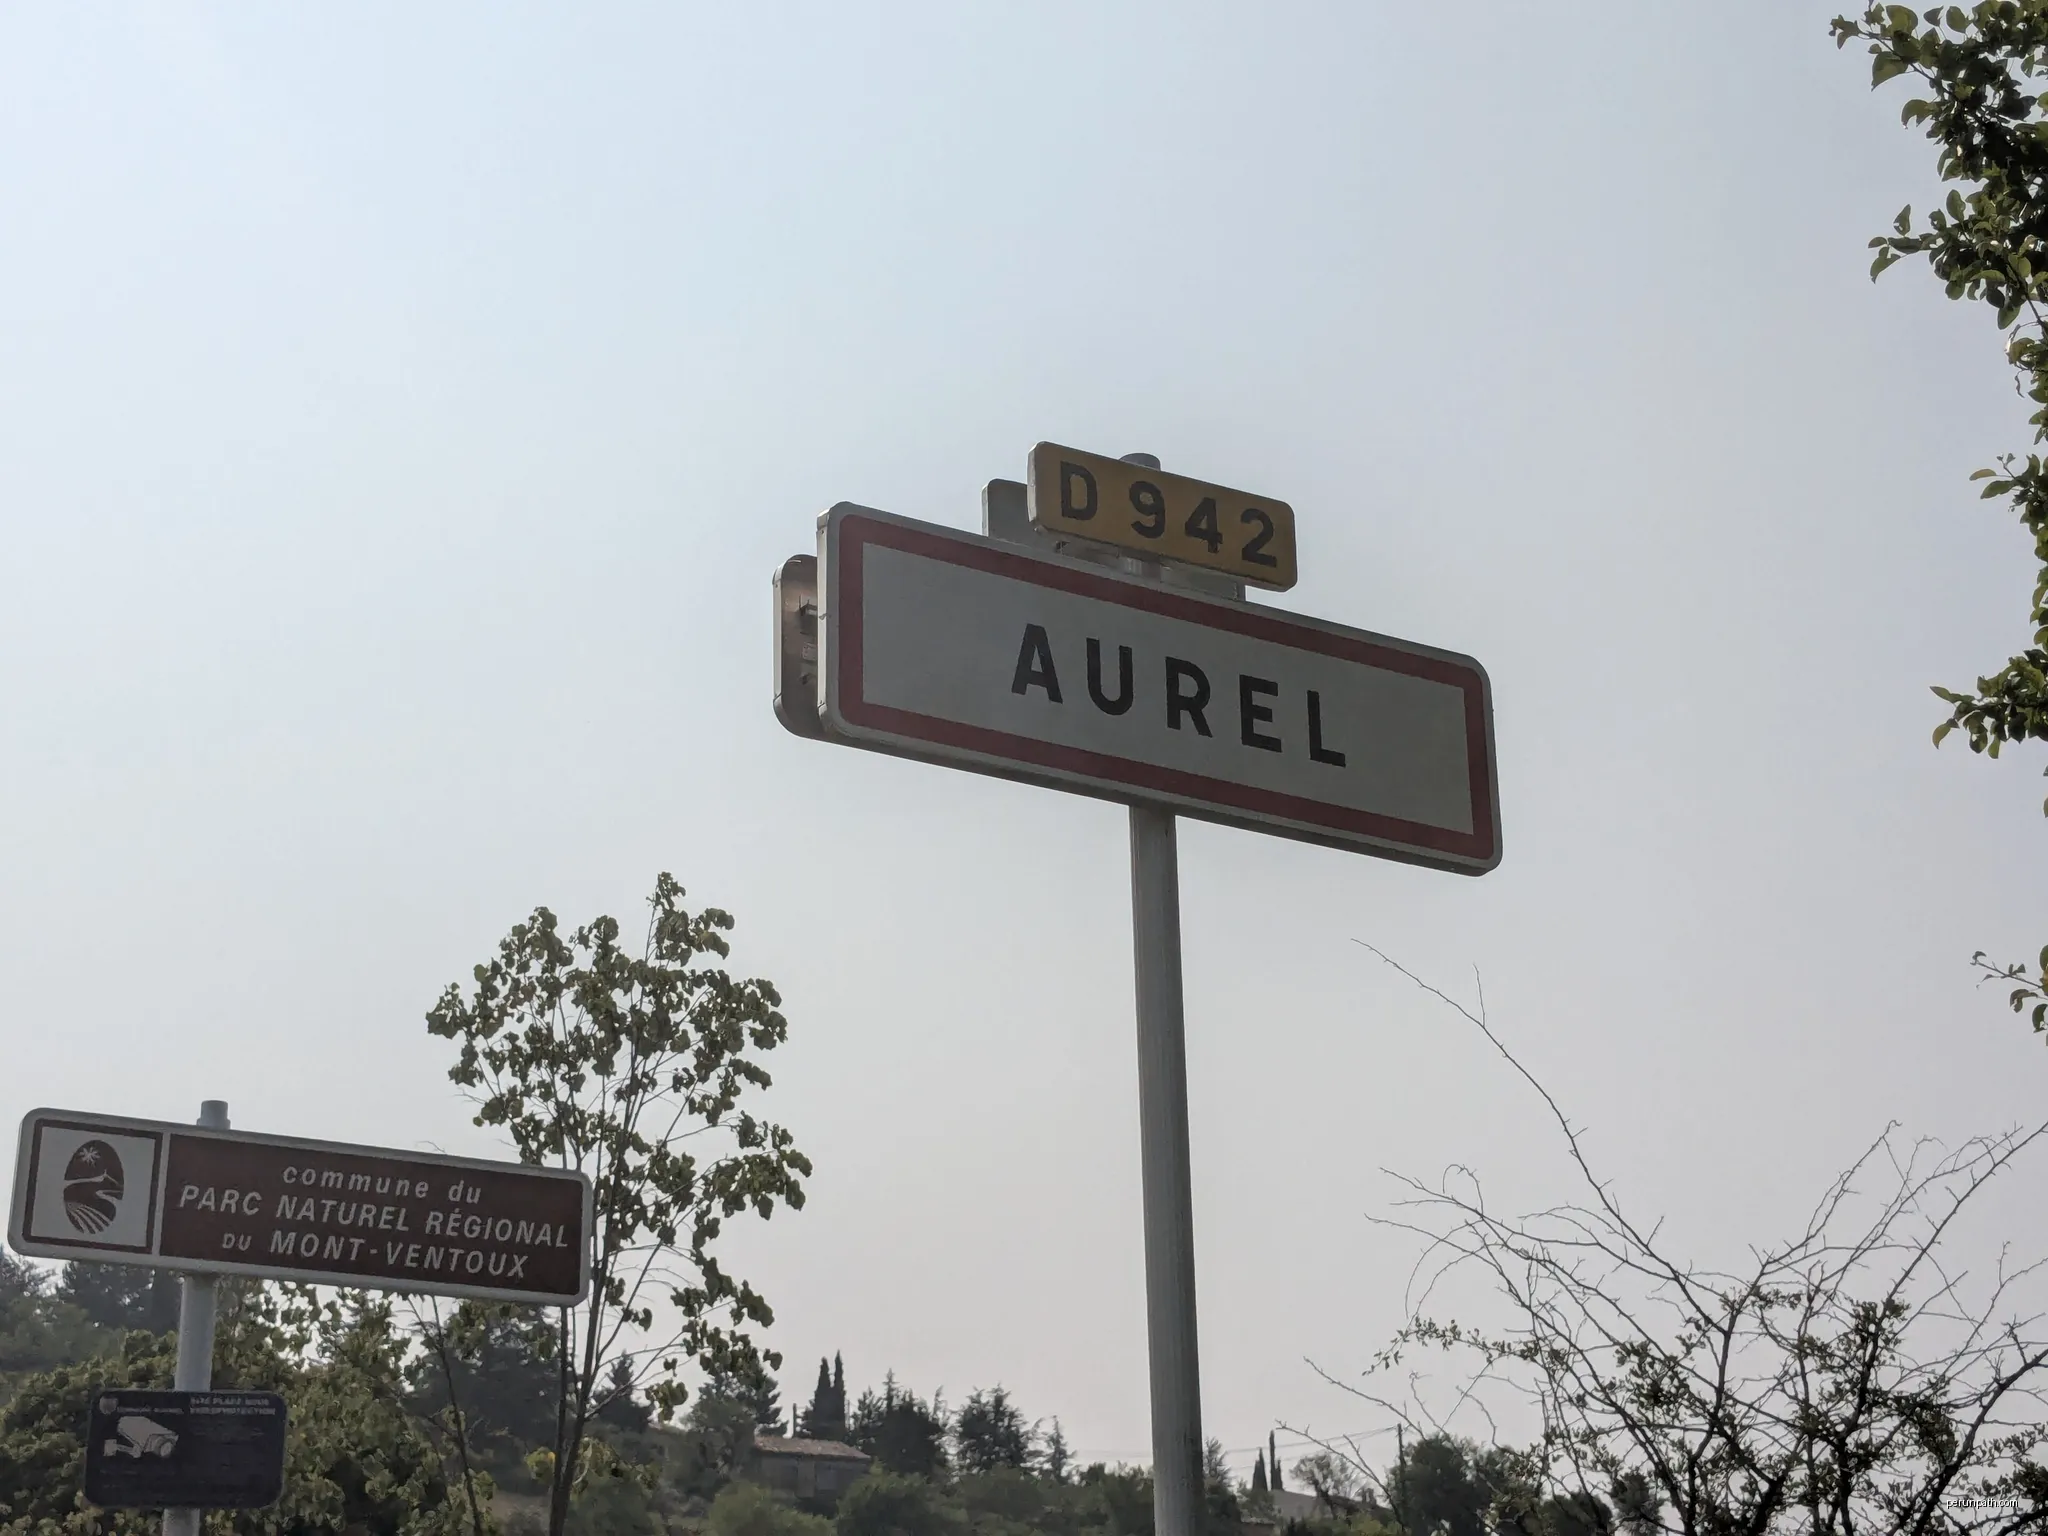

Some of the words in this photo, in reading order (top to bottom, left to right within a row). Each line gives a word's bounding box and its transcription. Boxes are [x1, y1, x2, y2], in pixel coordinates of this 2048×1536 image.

[1060, 460, 1099, 521] D
[1129, 480, 1278, 568] 942
[1010, 622, 1347, 769] AUREL
[179, 1185, 263, 1216] PARC
[275, 1194, 410, 1232] NATUREL
[425, 1207, 569, 1248] RÉGIONAL
[283, 1166, 429, 1198] commune
[448, 1180, 482, 1205] du
[222, 1232, 252, 1252] DU
[269, 1229, 529, 1279] MONT-VENTOUX
